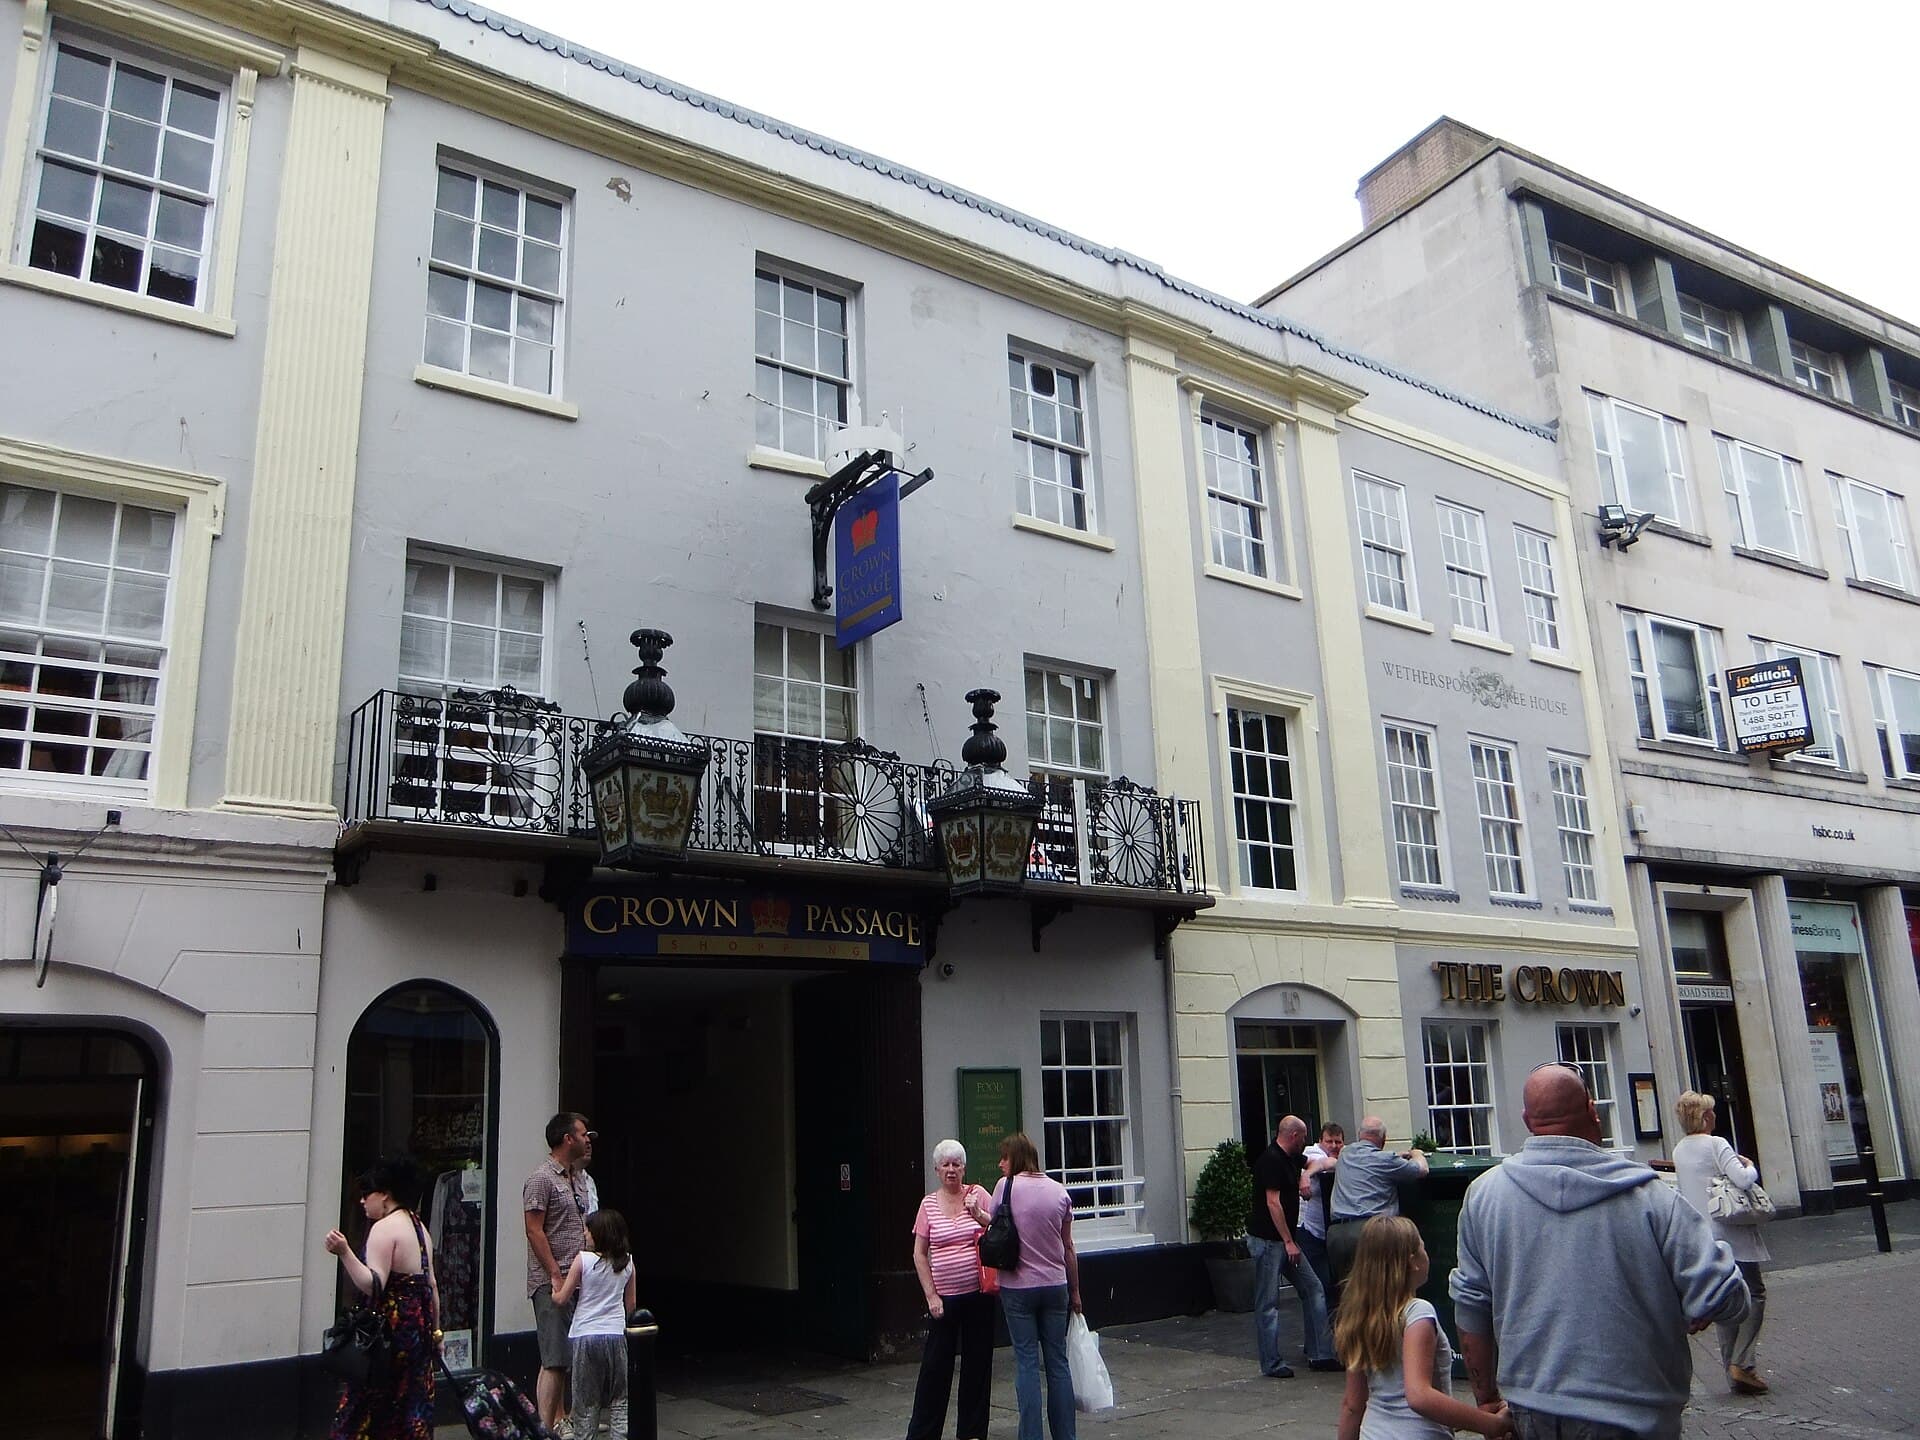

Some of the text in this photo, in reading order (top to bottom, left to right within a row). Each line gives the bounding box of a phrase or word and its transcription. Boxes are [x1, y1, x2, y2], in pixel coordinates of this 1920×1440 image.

[840, 547, 891, 592] CROWN
[840, 569, 892, 611] PASSAGE
[1736, 669, 1791, 688] jpdillon
[1530, 695, 1568, 716] HOUSE
[1741, 691, 1791, 708] TO LET
[1741, 729, 1805, 745] 01905 670 900
[1812, 825, 1856, 841] hsbc.co.uk
[584, 895, 921, 945] CROWN PASSAGE
[1791, 923, 1841, 940] inessBanking
[1432, 961, 1626, 1007] THE CROWN
[1702, 987, 1730, 999] STREET
